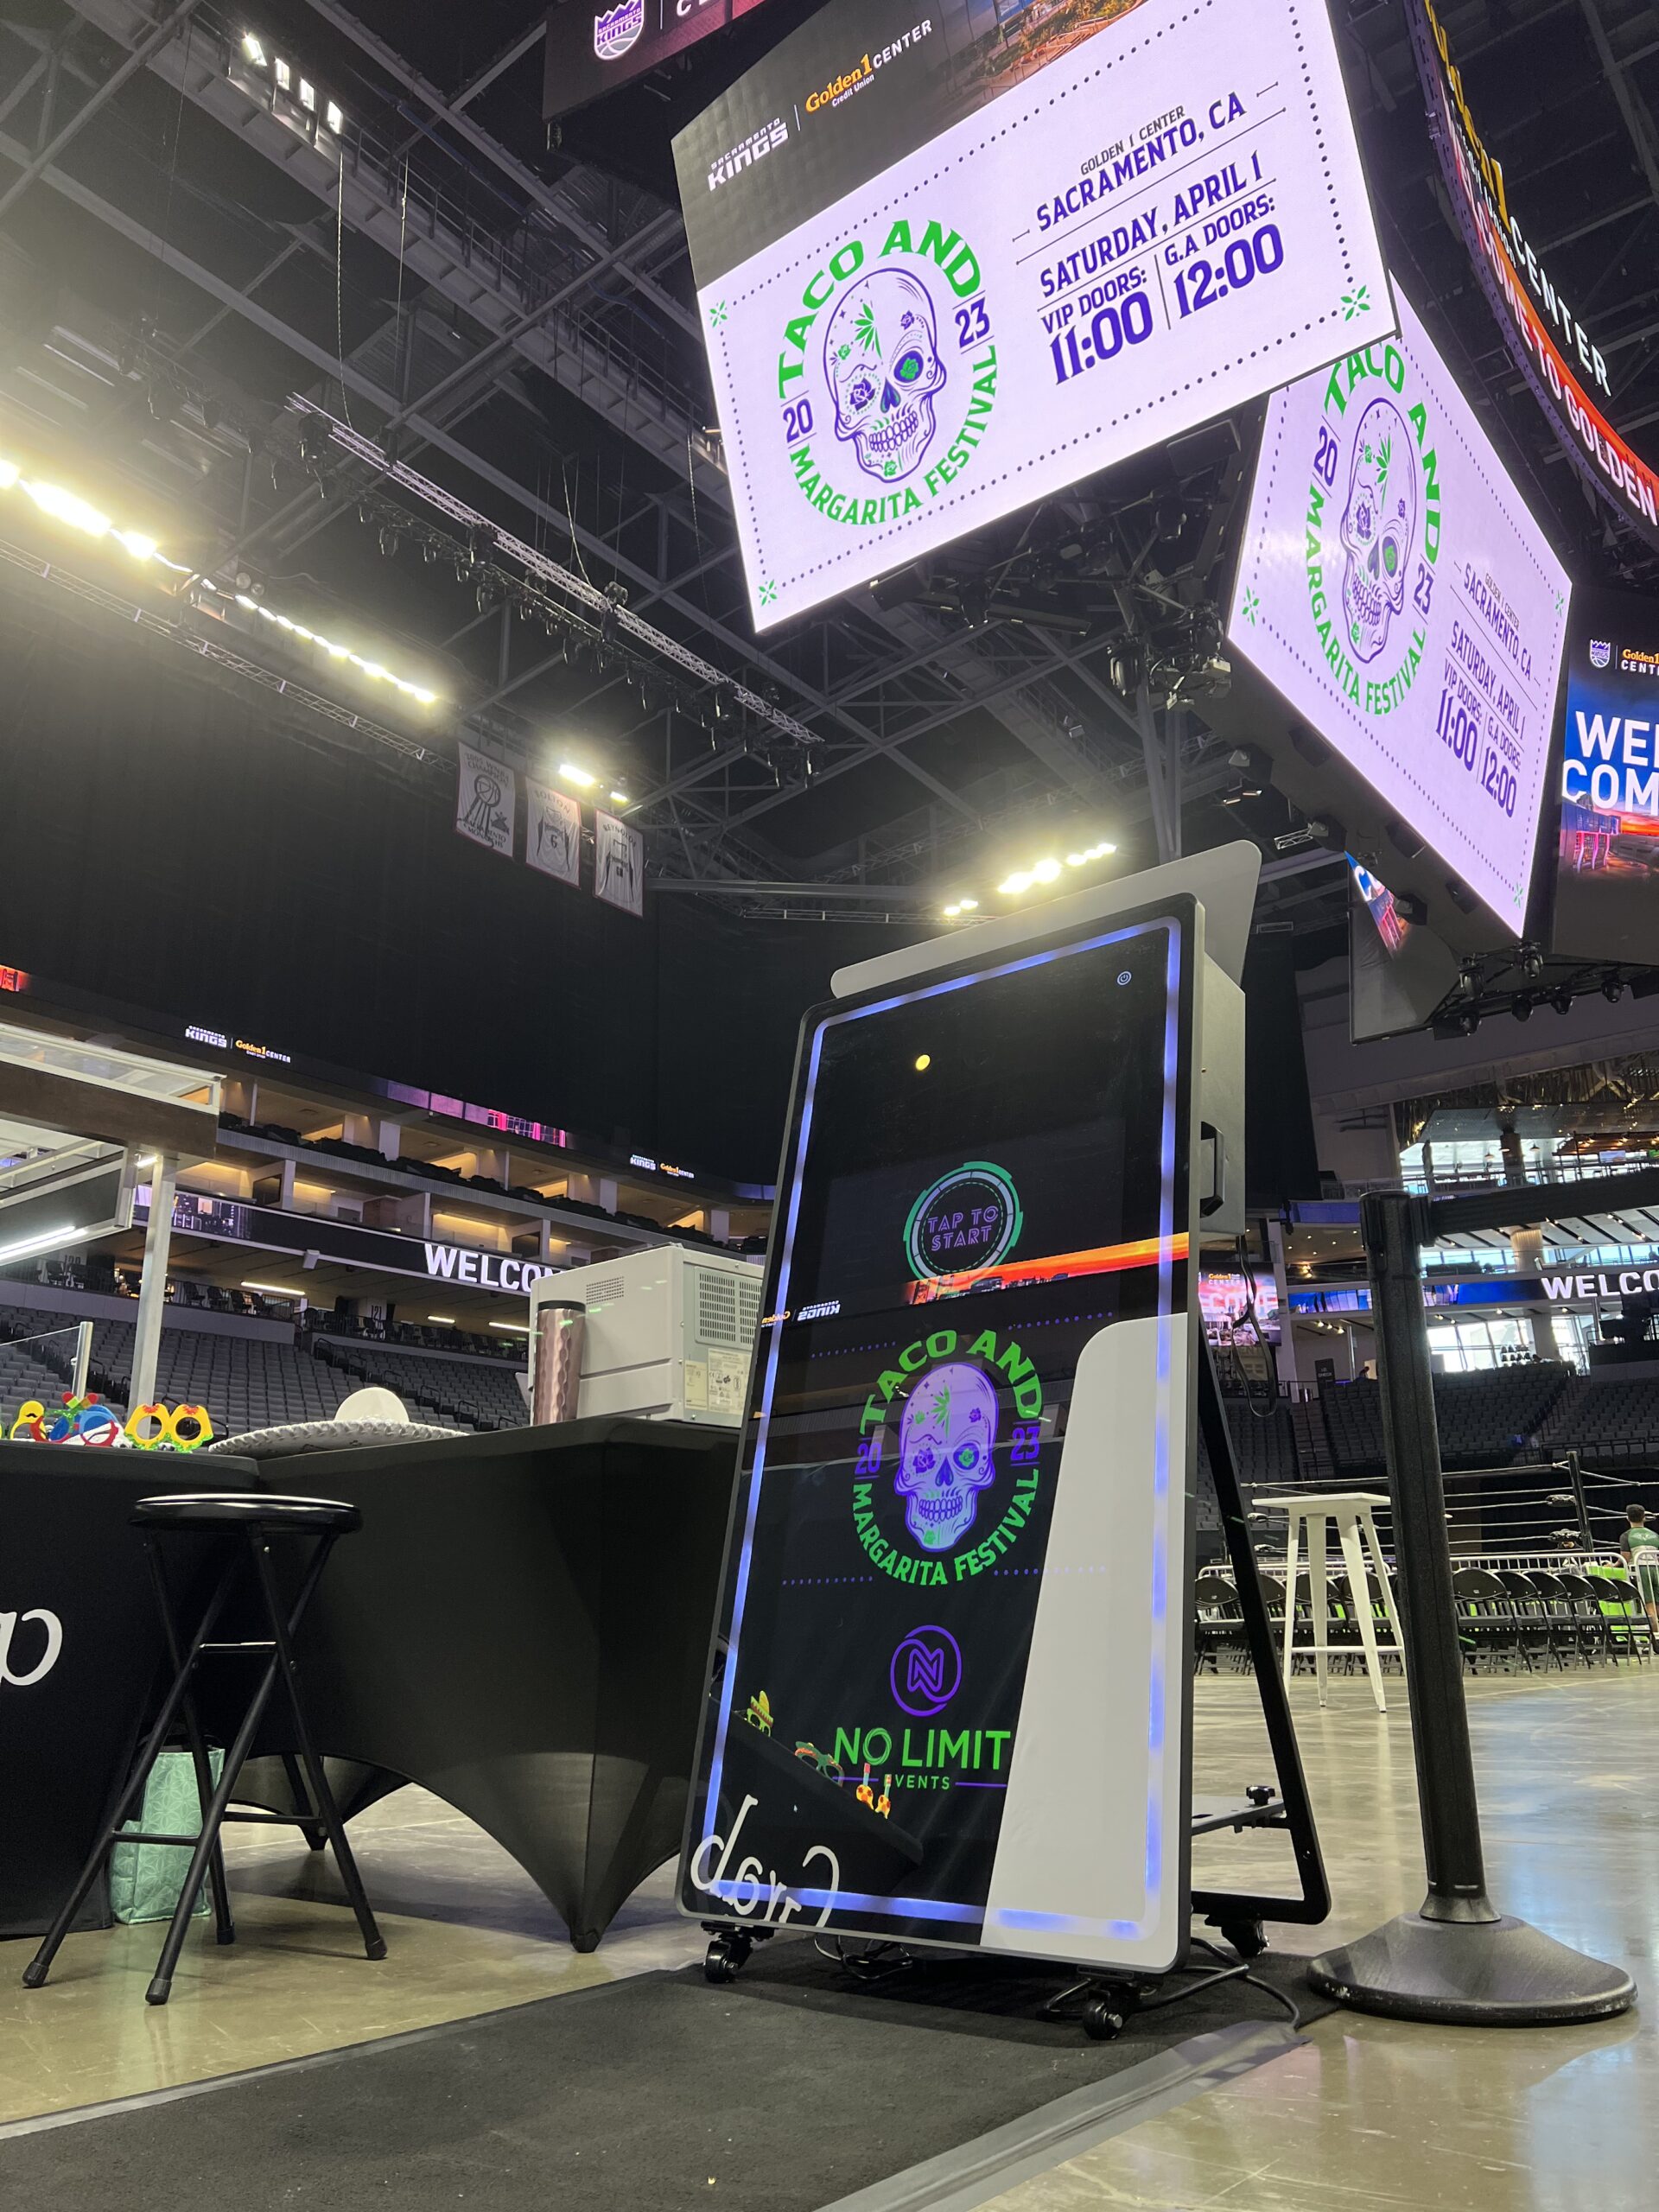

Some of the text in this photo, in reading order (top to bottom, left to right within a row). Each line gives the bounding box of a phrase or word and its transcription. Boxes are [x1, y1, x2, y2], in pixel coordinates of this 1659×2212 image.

[597, 15, 642, 47] KINGS
[874, 18, 933, 68] CENTER
[832, 73, 875, 108] Credit Union
[708, 121, 789, 191] KINGS
[710, 118, 781, 169] SACRAMENTO
[1036, 92, 1247, 232] SACRAMENTO, CA
[1080, 140, 1124, 175] GOLDEN
[1139, 105, 1185, 142] CENTER
[1039, 206, 1169, 297] SATURDAY,
[1173, 163, 1247, 227] APRIL
[1164, 194, 1276, 266] G.A DOORS:
[1040, 264, 1148, 334] VIP DOORS:
[1173, 223, 1285, 319] 12:00
[779, 219, 982, 398] TACO AND
[955, 296, 990, 347] 23
[1049, 290, 1154, 385] 11:00
[1510, 216, 1611, 397] CENTER
[783, 398, 813, 442] 20
[790, 345, 997, 525] MARGARITA FESTIVAL
[1531, 325, 1563, 400] TO
[1564, 384, 1658, 526] GOLDEN
[1313, 426, 1338, 487] 20
[1324, 343, 1441, 566] TACO AND
[1306, 481, 1427, 716] MARGARITA FESTIVAL
[1414, 563, 1433, 615] 23
[1484, 573, 1502, 603] GOLDEN
[1504, 603, 1520, 632] CENTER
[1464, 563, 1531, 681] SACRAMENTO, CA
[1444, 658, 1482, 726] VIP DOORS:
[1451, 620, 1497, 703] SATURDAY,
[1497, 683, 1519, 734] APRIL
[1621, 659, 1659, 676] CENT
[1435, 688, 1478, 772] 11:00
[1500, 730, 1522, 773] DOORS:
[1575, 711, 1659, 768] WE
[1480, 746, 1517, 818] 12:00
[185, 1028, 226, 1048] KINGS
[266, 1050, 290, 1063] CENTER
[630, 1156, 656, 1171] KINGS
[927, 1205, 998, 1233] TAP TO
[931, 1225, 991, 1251] START
[423, 1243, 567, 1293] WELCO
[860, 1329, 957, 1435] TACO
[965, 1329, 1043, 1420] AND
[855, 1443, 881, 1475] 20
[1011, 1427, 1039, 1460] 23
[852, 1469, 1039, 1586] MARGARITA FESTIVAL
[834, 1727, 1011, 1770] NO LIMIT
